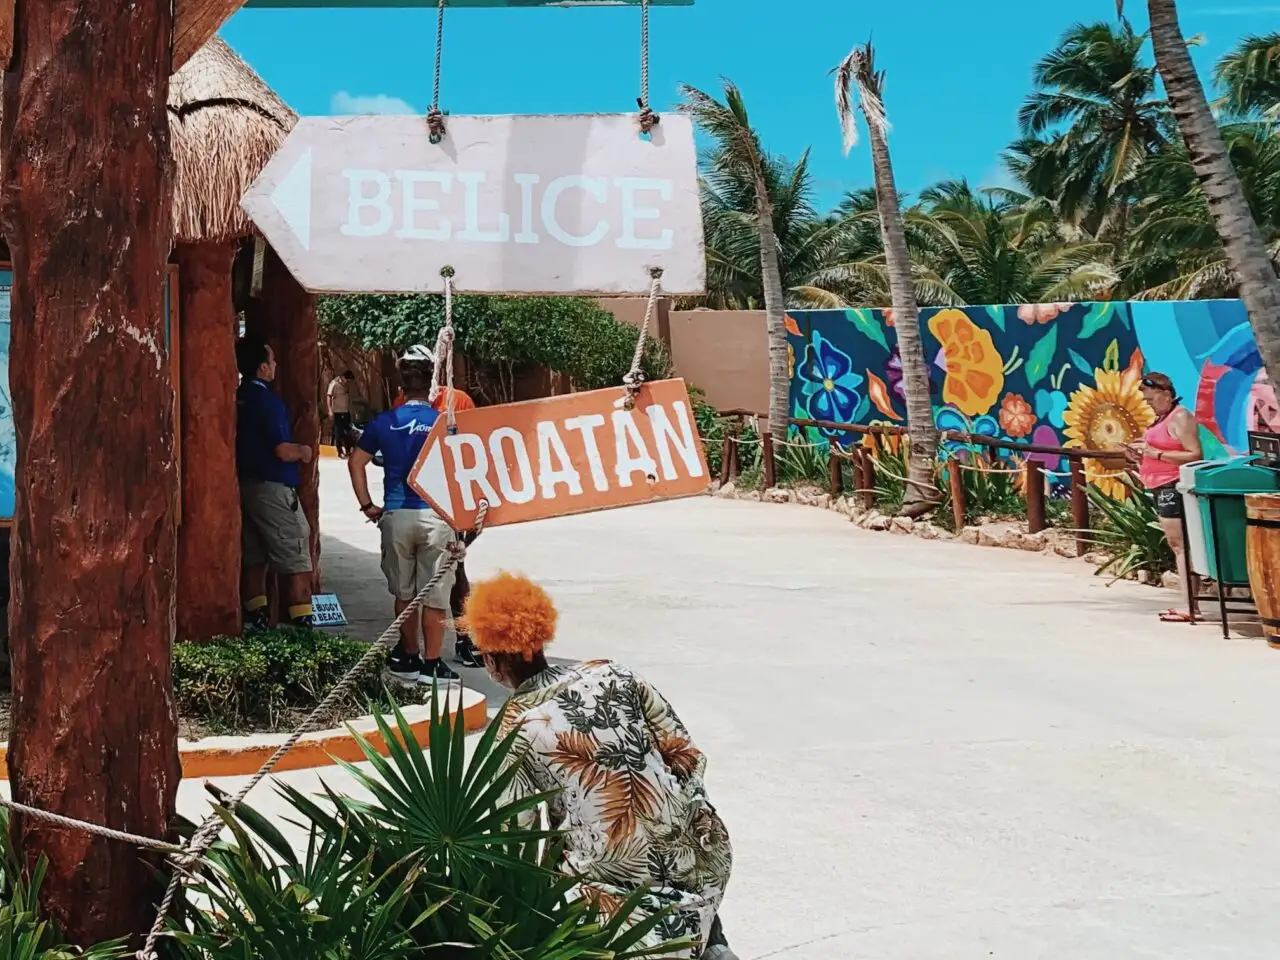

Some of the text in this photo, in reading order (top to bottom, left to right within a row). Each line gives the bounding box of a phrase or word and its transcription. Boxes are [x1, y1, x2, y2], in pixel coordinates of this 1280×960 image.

[340, 168, 674, 250] BELICE
[444, 398, 704, 511] ROATÁN
[316, 603, 339, 612] BUGGY
[318, 612, 344, 622] BEACH
